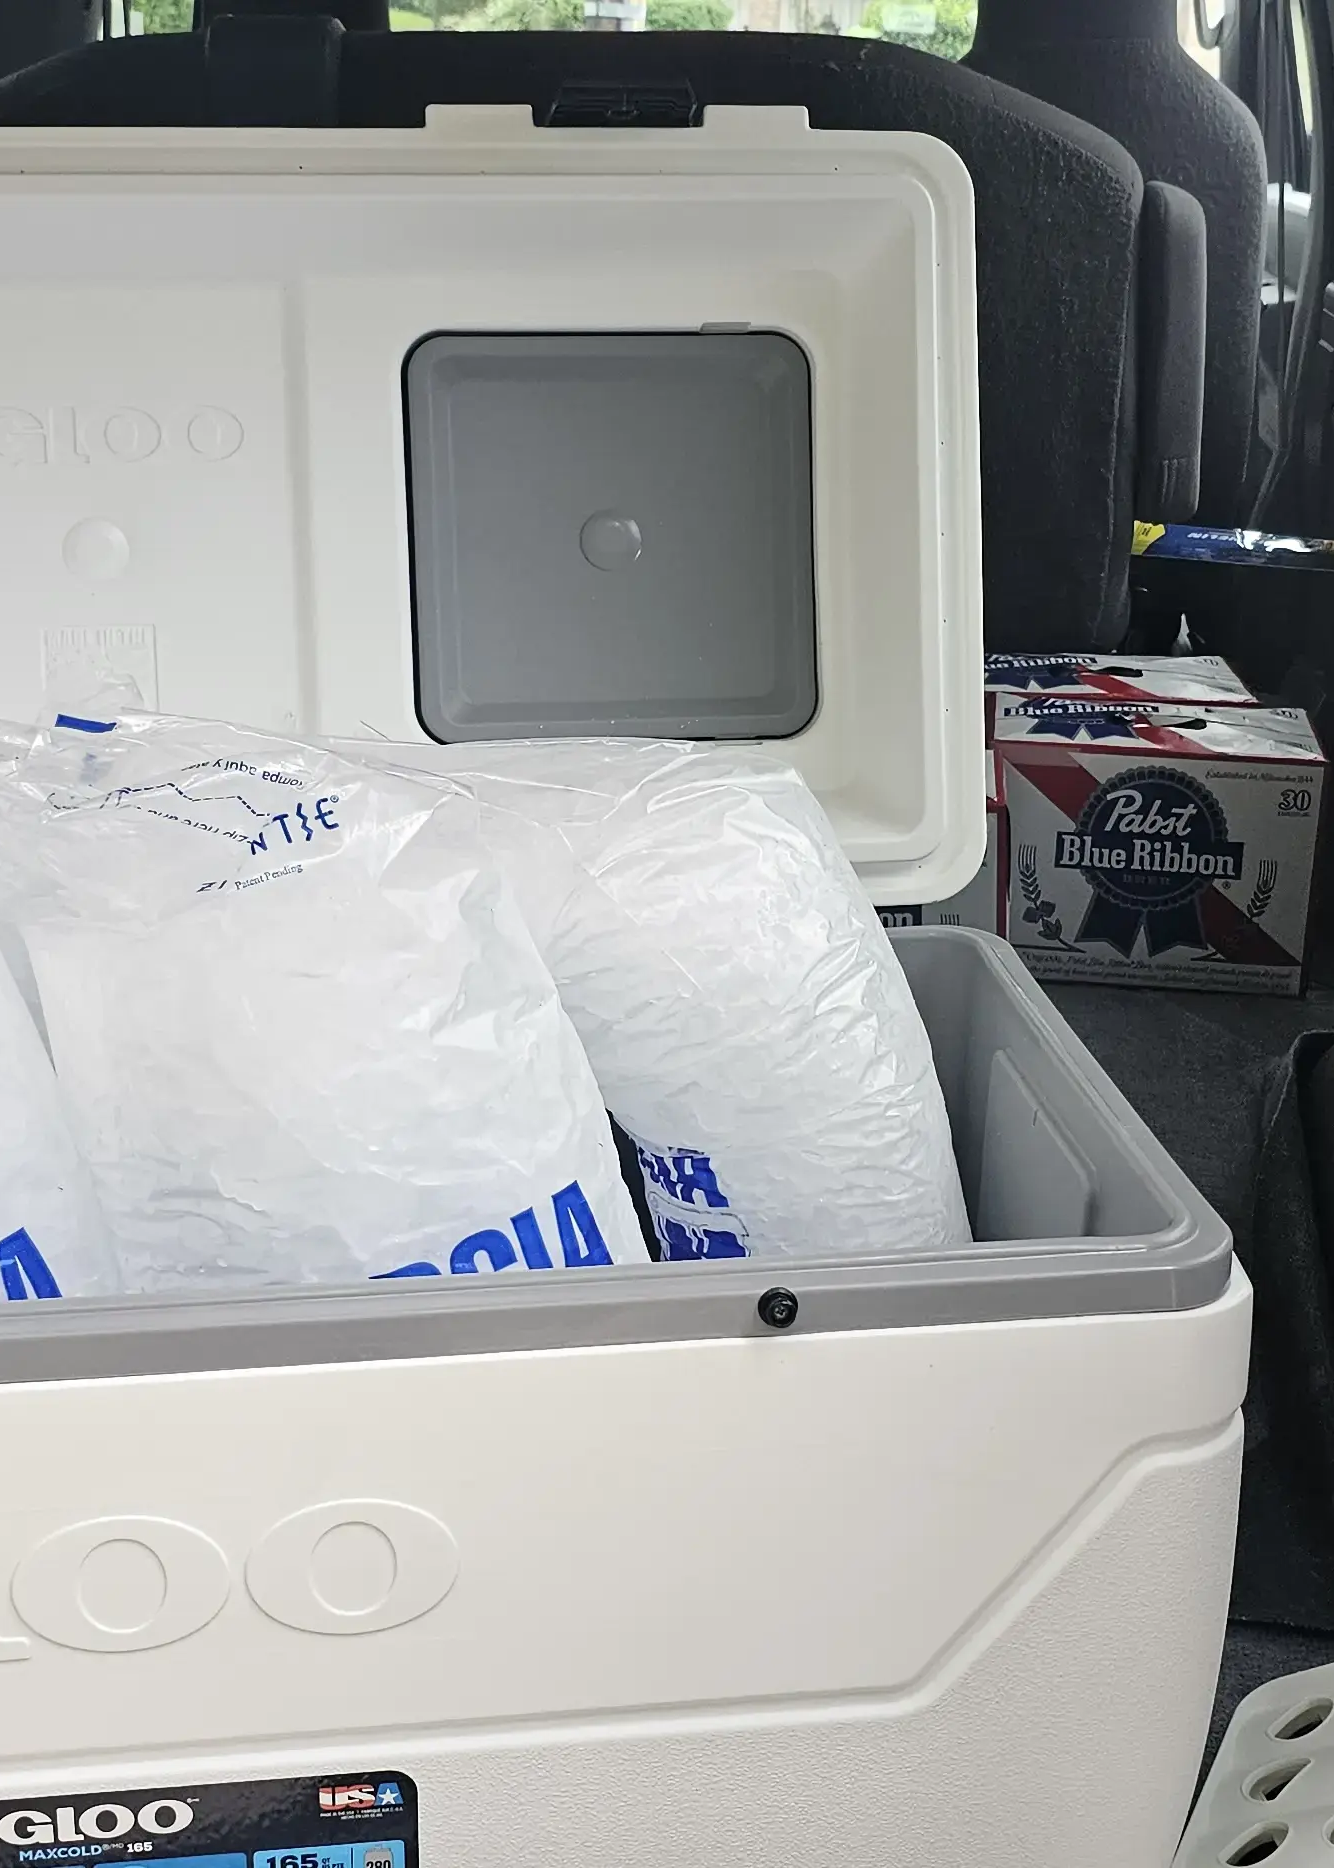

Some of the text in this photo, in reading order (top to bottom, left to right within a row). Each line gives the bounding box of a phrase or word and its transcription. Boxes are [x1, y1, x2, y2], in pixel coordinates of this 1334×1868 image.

[1104, 788, 1198, 837] Pabst
[1278, 788, 1312, 812] 30
[1060, 834, 1236, 876] Blue Ribbon
[234, 863, 304, 891] Patent Pending
[318, 1782, 404, 1812] USA
[126, 1841, 154, 1854] 165
